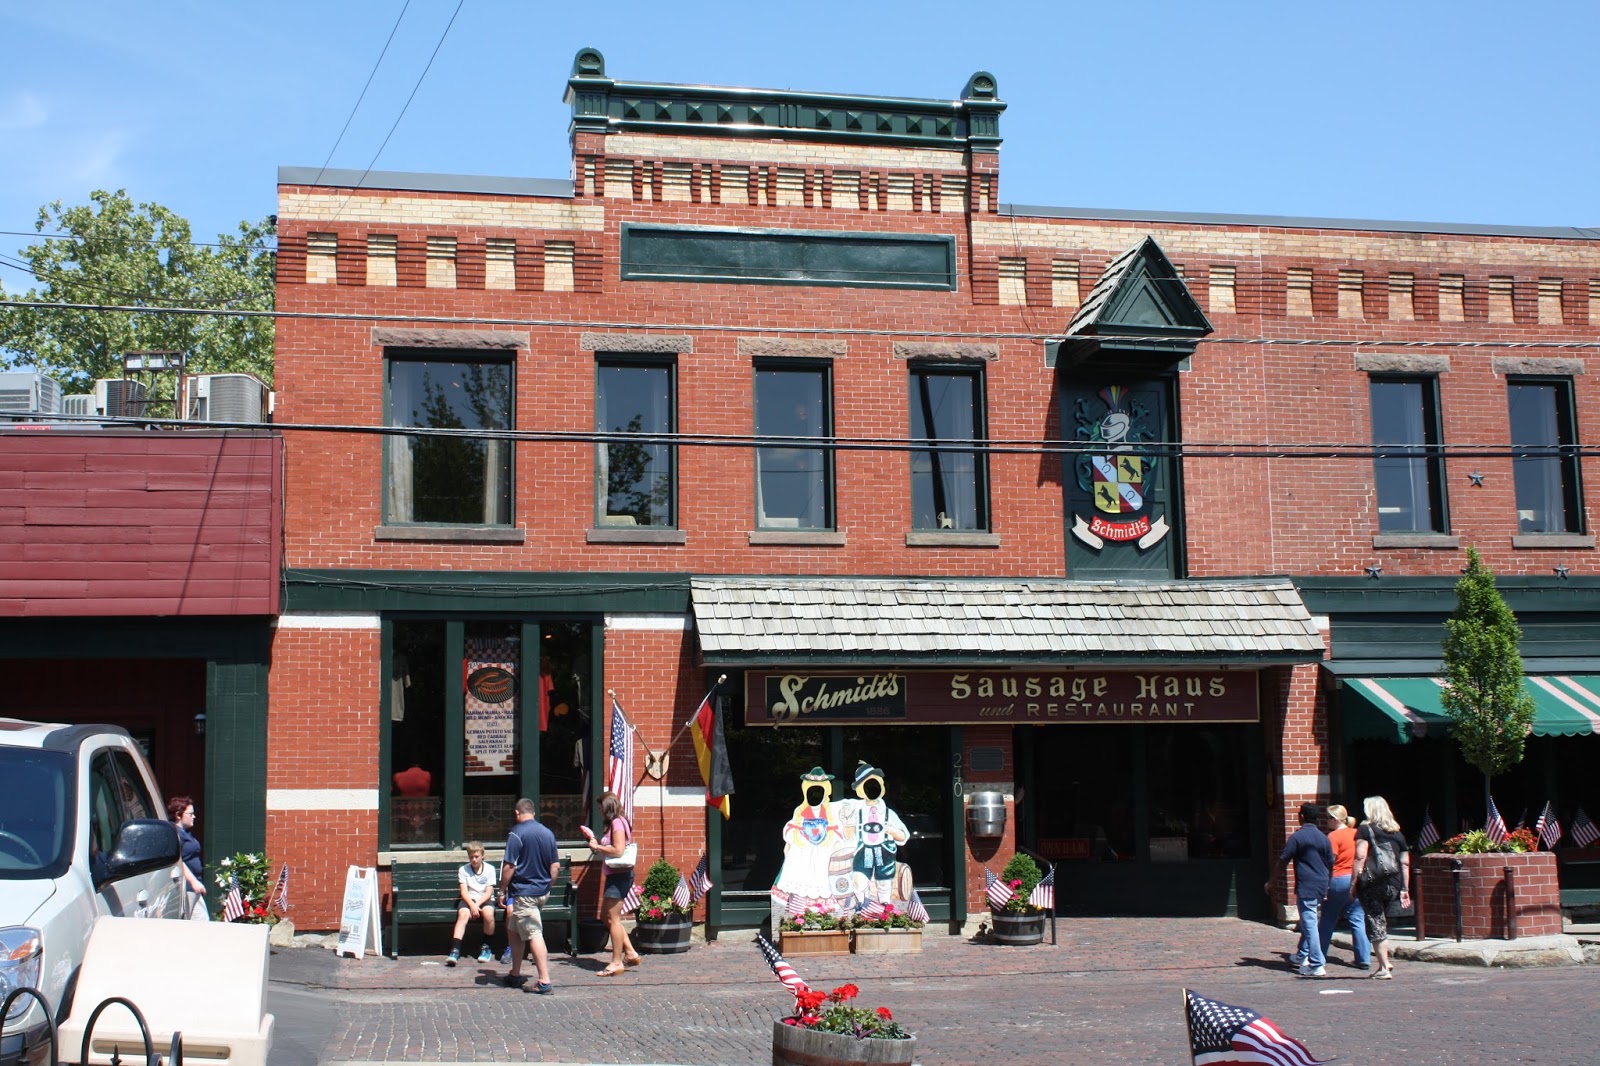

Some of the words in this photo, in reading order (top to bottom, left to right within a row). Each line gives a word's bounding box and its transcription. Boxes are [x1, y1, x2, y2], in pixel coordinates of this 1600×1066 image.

[1091, 519, 1149, 539] Schmidt's
[951, 673, 1109, 701] Sausage
[1135, 674, 1226, 700] Haus
[772, 673, 899, 729] Schmidt's
[978, 703, 1015, 717] und
[1026, 702, 1196, 717] RESTAURANT
